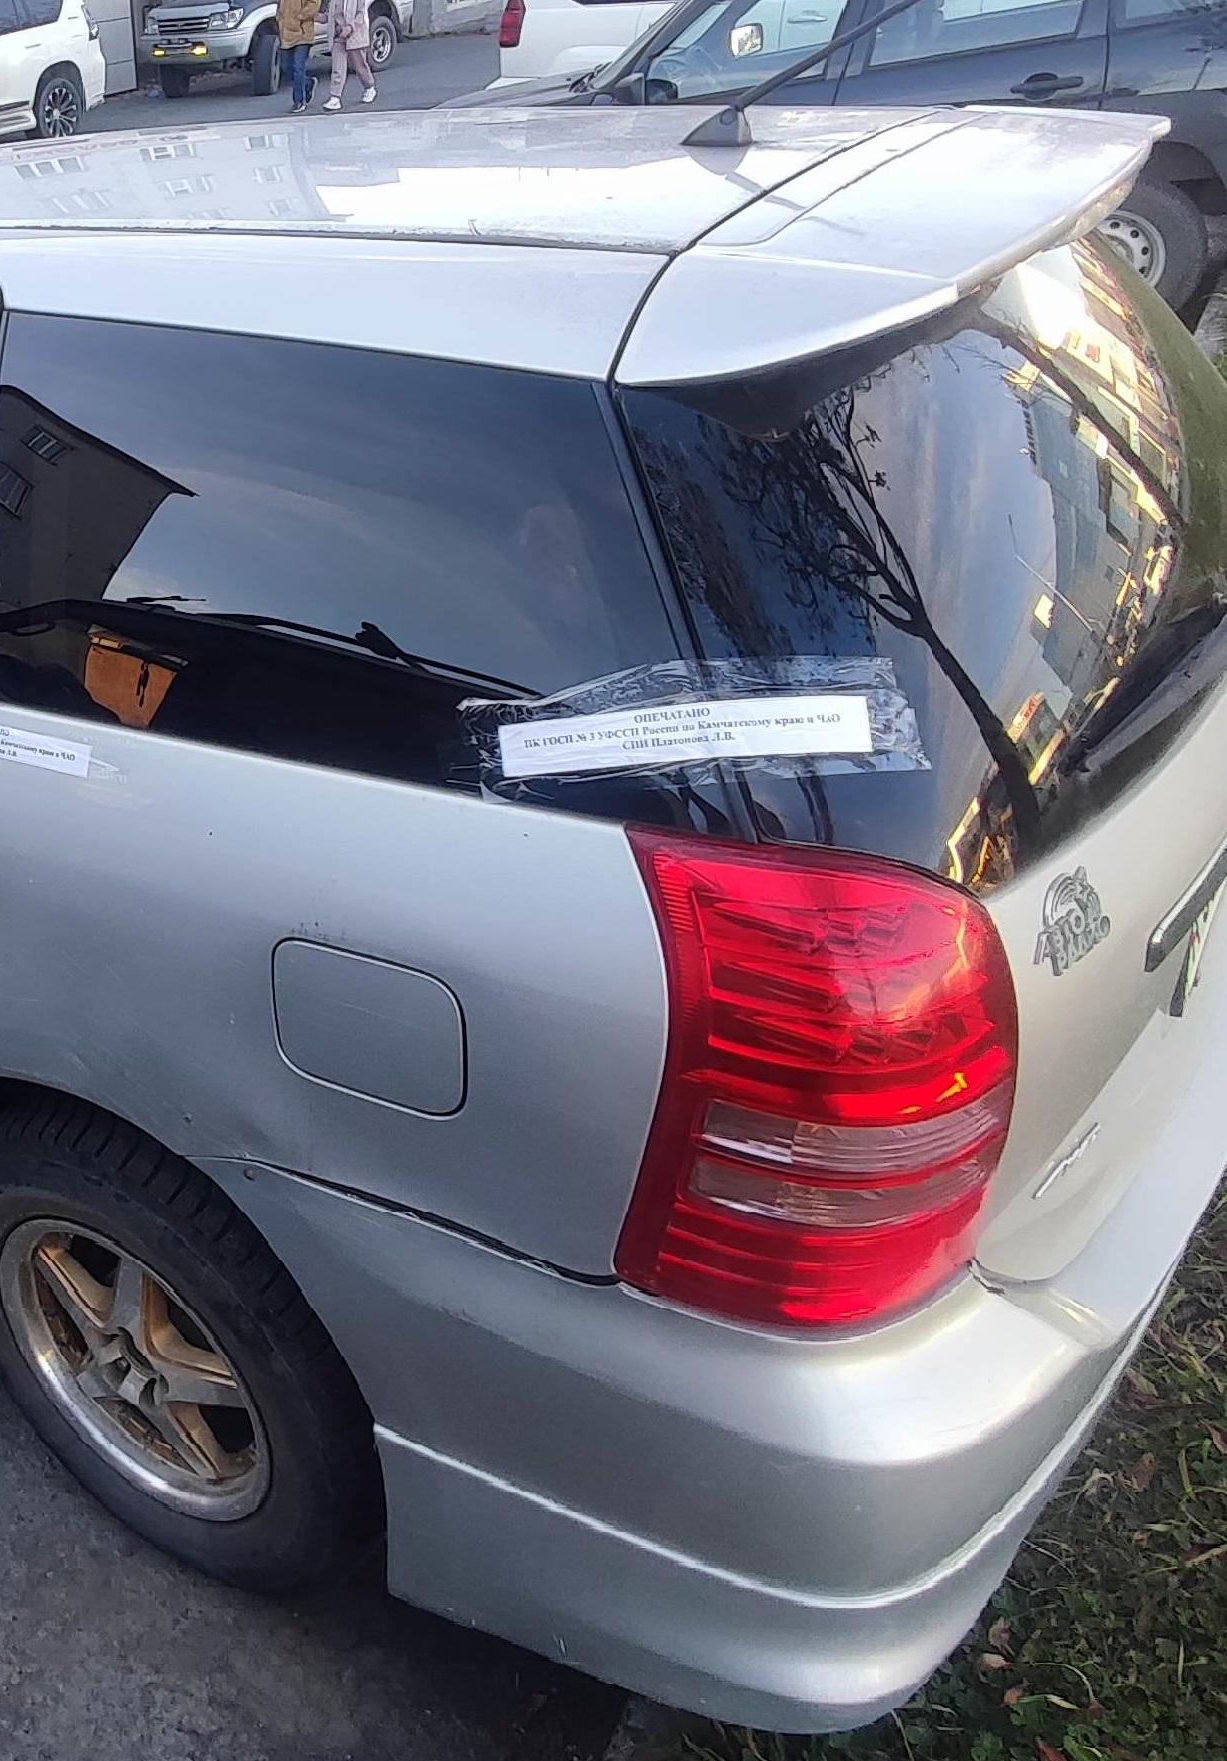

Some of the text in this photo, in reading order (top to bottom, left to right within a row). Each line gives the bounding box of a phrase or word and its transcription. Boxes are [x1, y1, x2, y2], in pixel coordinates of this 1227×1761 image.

[634, 707, 711, 724] ОПЕЧАТАНО
[524, 738, 541, 749] ПК
[542, 734, 573, 747] ГОСП
[575, 733, 587, 743] №
[589, 732, 596, 741] 3
[598, 727, 640, 741] УФССП
[642, 723, 679, 735] России
[682, 724, 695, 732] по
[698, 717, 771, 731] Камчатскому
[775, 716, 805, 727] краю
[807, 715, 814, 724] и
[622, 737, 649, 751] СПИ
